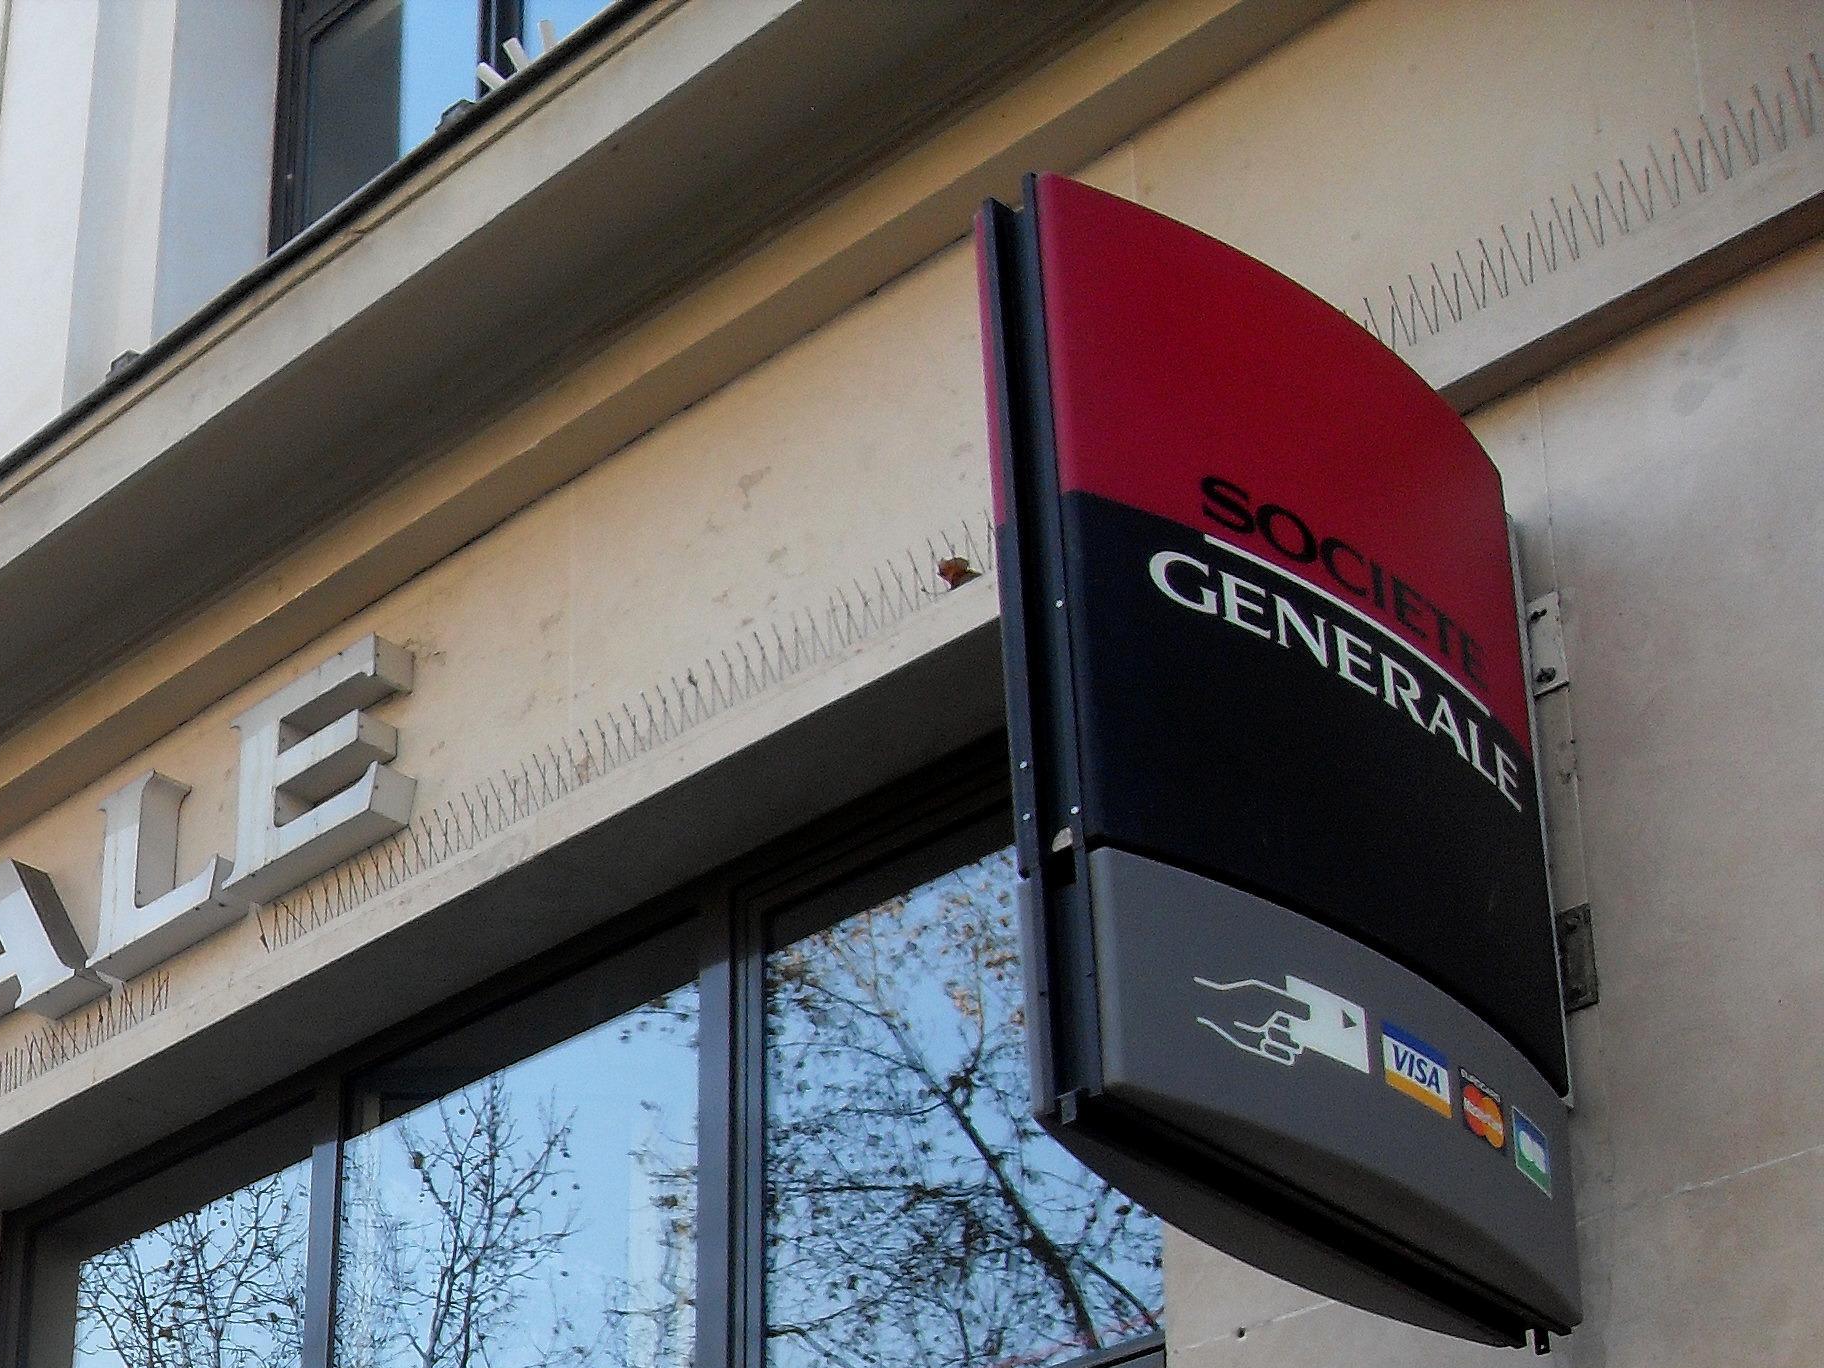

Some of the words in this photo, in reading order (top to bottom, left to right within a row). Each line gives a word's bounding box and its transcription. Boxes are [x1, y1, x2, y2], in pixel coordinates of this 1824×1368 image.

[1149, 551, 1522, 812] GENERALE
[1200, 475, 1488, 692] SOCIETE
[1392, 1043, 1441, 1095] VISA
